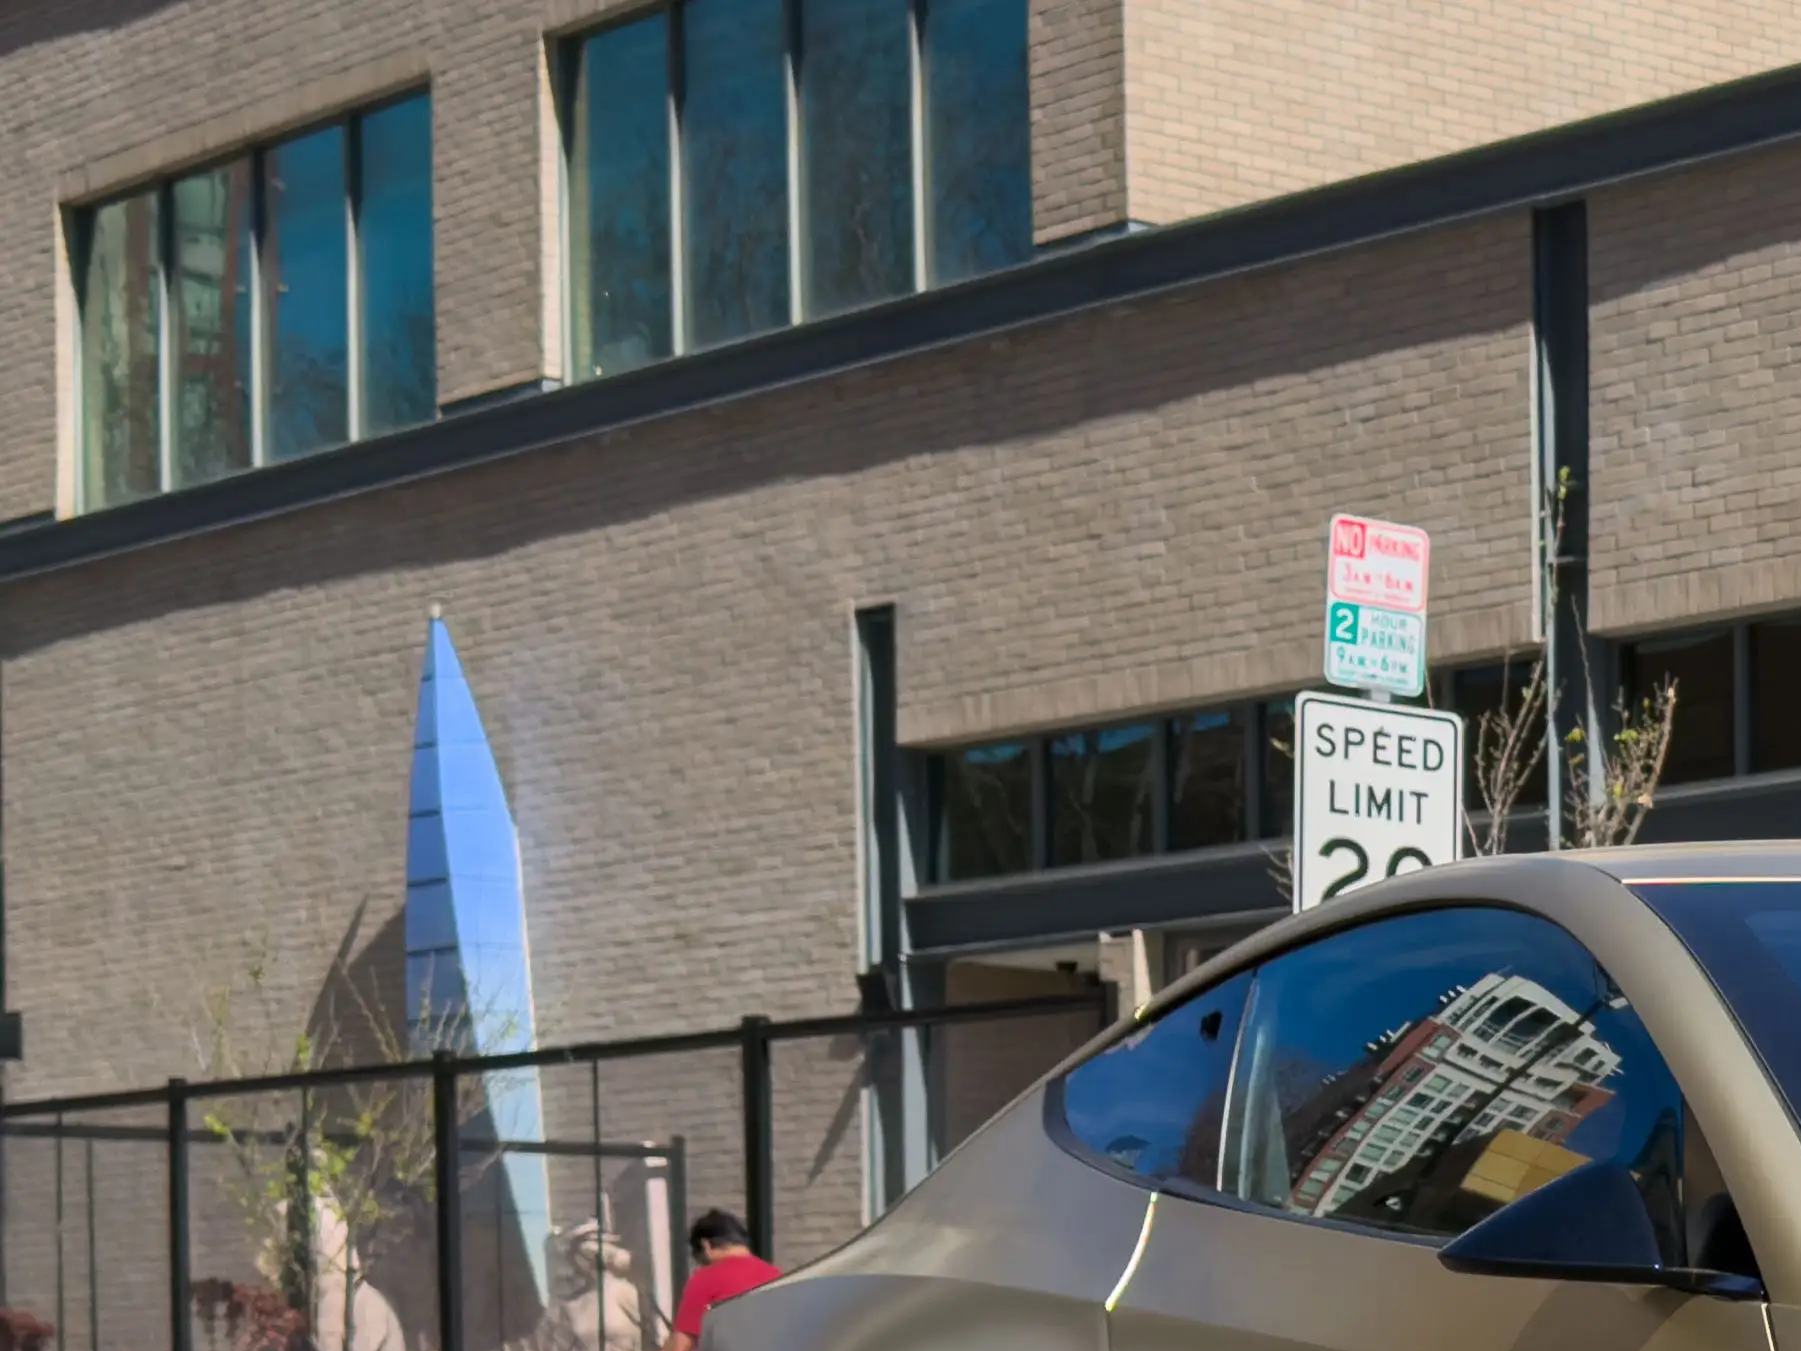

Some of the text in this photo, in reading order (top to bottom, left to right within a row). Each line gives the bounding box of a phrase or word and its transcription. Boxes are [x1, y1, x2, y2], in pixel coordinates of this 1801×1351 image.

[1336, 522, 1364, 556] NO
[1335, 608, 1407, 640] 2 HOUR
[1361, 628, 1415, 655] PARKING
[1316, 724, 1444, 772] SPEED
[1330, 780, 1428, 824] LIMIT
